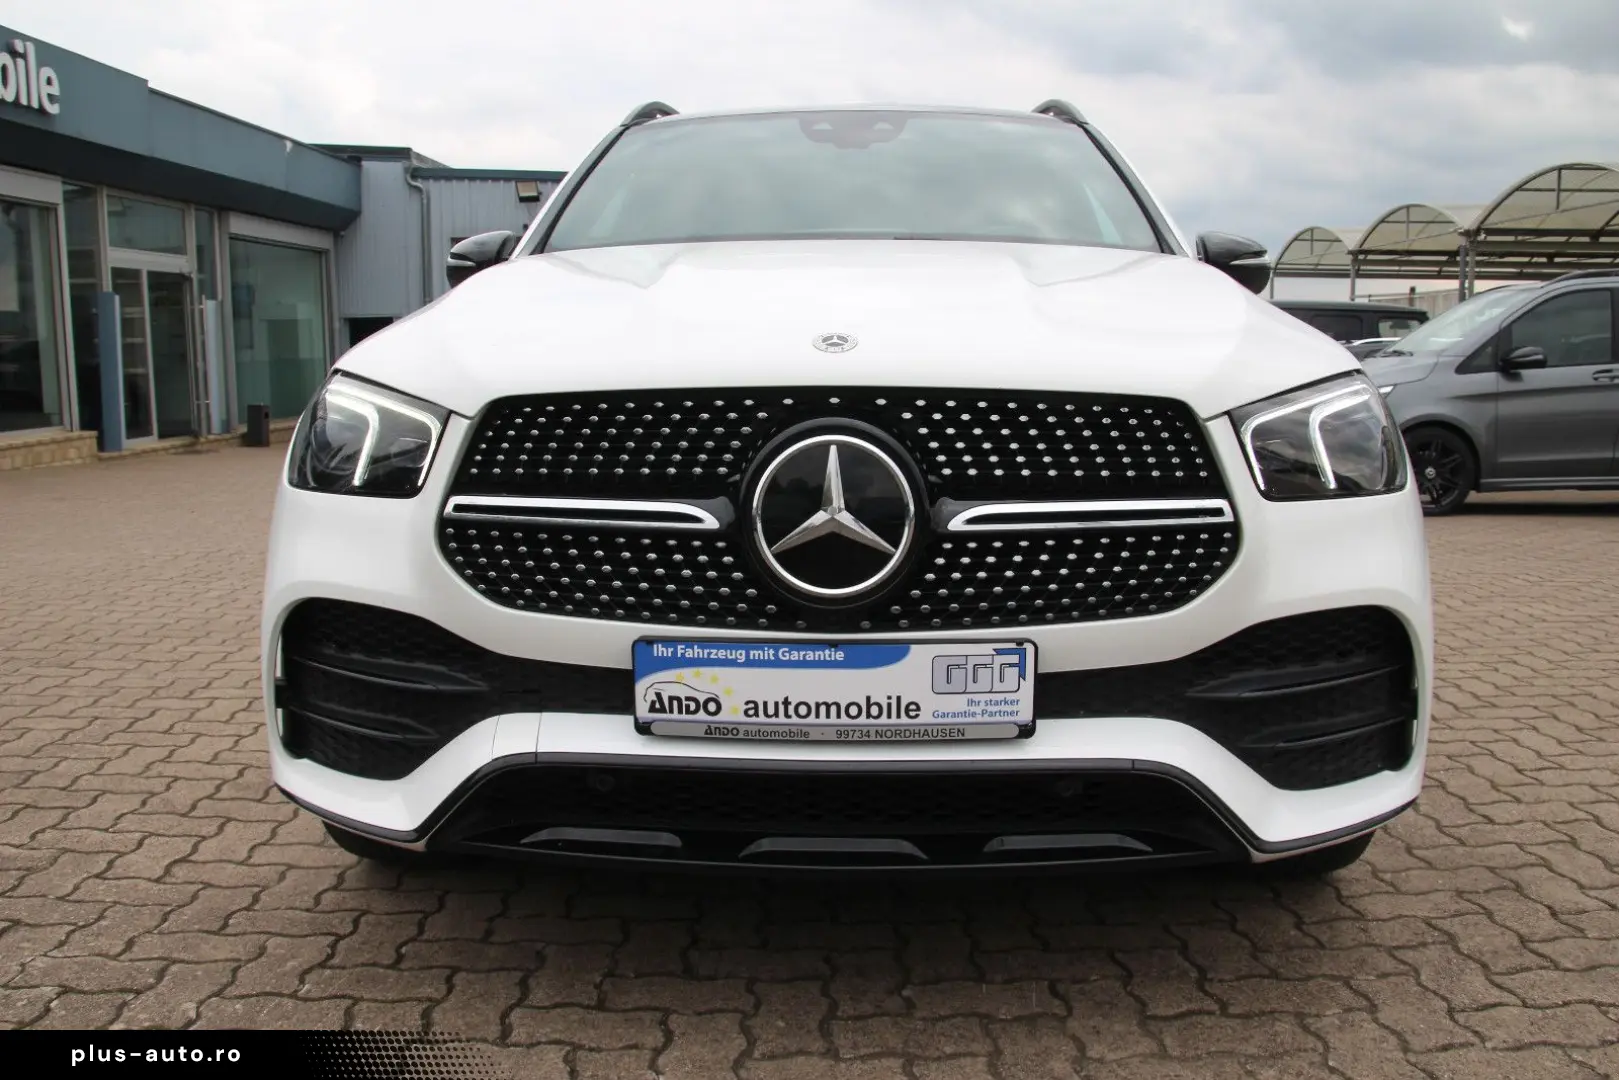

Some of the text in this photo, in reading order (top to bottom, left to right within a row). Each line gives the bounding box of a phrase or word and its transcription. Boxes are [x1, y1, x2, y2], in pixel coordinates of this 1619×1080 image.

[653, 644, 845, 662] Ihr Fahrzeug mit Garantie
[743, 695, 921, 720] automobile
[967, 697, 1020, 707] Ihr starker
[932, 708, 1020, 719] Garantie-Partner
[743, 728, 810, 739] automobile
[835, 729, 871, 739] 99734
[875, 728, 966, 739] NORDHAUSEN
